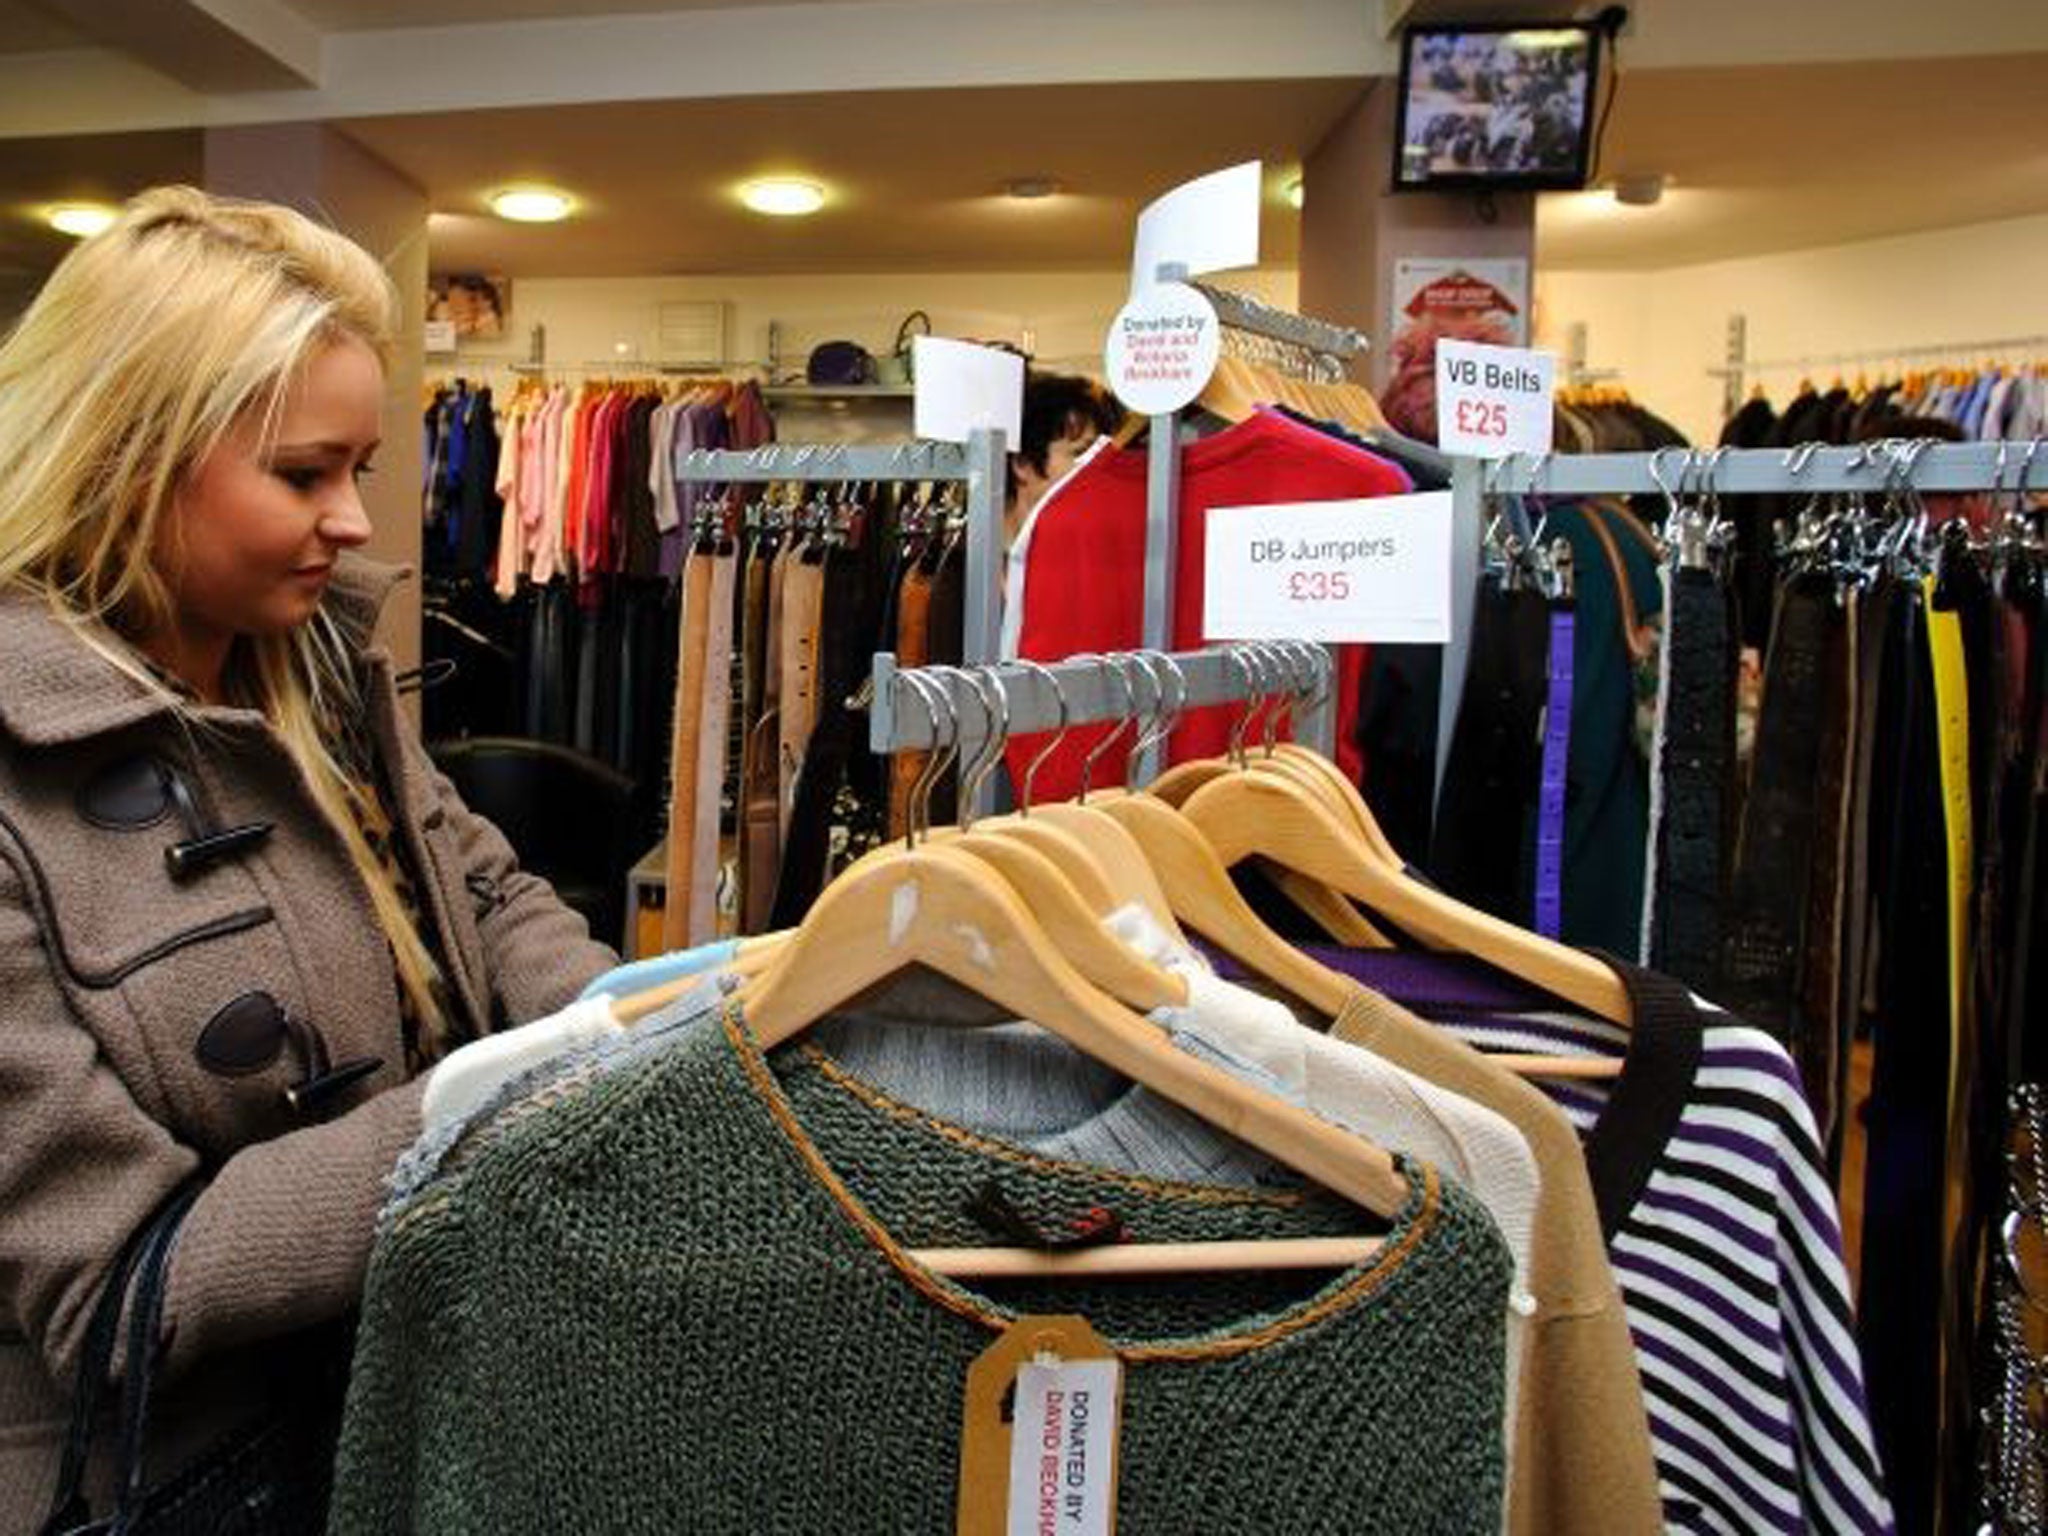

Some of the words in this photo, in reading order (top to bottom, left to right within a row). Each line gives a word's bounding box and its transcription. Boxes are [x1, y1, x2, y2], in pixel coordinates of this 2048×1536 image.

[1446, 358, 1477, 385] VB
[1485, 363, 1541, 393] Belts
[1456, 399, 1508, 437] £25
[1250, 539, 1286, 563] DB
[1291, 536, 1397, 563] Jumpers
[1289, 570, 1350, 601] £35
[1043, 1391, 1064, 1450] DAVID
[1066, 1391, 1089, 1487] DONATED
[1038, 1455, 1060, 1536] BECKHA
